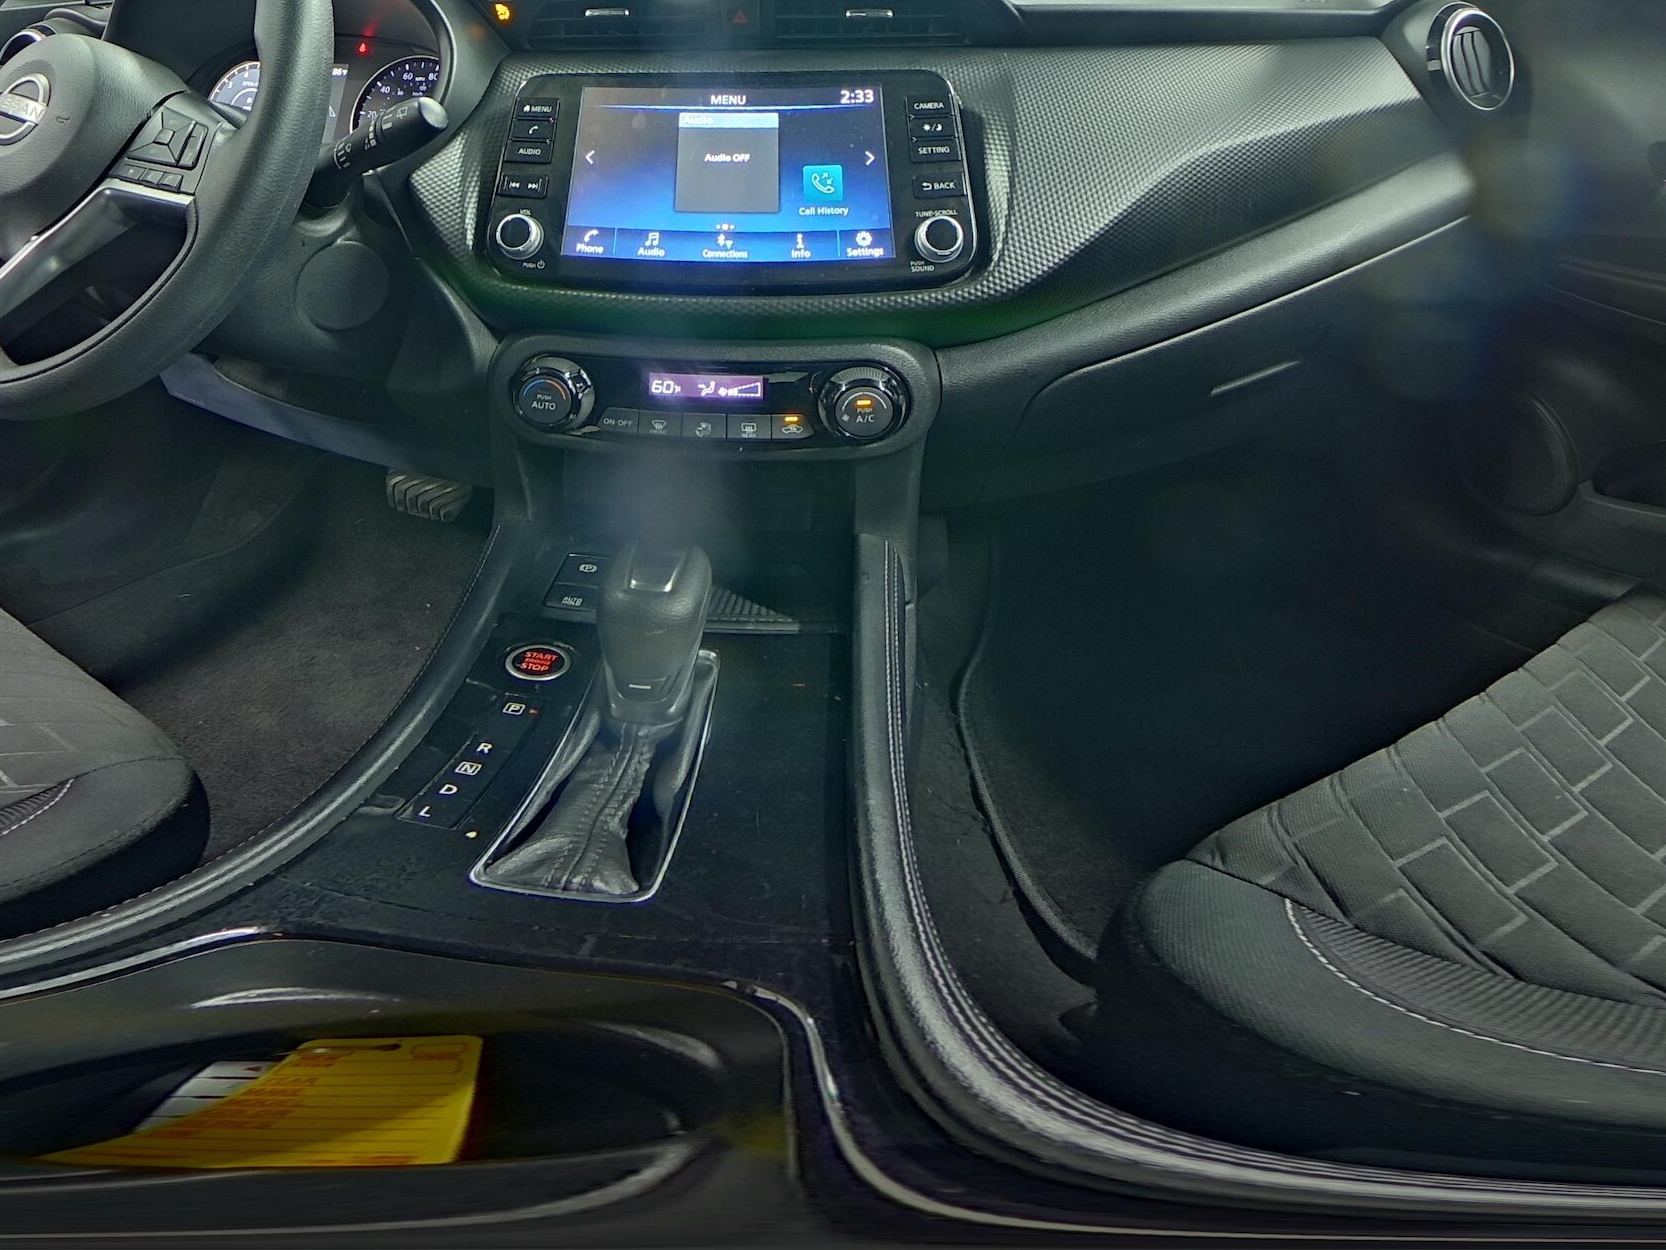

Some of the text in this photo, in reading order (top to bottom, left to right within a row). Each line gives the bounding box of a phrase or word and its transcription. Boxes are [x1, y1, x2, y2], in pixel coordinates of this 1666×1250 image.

[403, 72, 413, 80] 60
[227, 81, 234, 89] 3
[380, 86, 391, 94] 40
[711, 90, 874, 105] MENU 2:33
[531, 105, 552, 113] MENU
[914, 102, 945, 110] CAMERA
[683, 115, 714, 125] Audio
[918, 146, 950, 155] SETTING
[704, 153, 750, 162] Audio OFF
[934, 181, 956, 190] BACK
[799, 207, 849, 217] Call History
[576, 243, 604, 254] Phone
[637, 247, 665, 258] Audio
[847, 247, 884, 258] Settings
[702, 249, 749, 260] Connections
[791, 249, 811, 259] Info
[522, 261, 536, 269] PUSH
[911, 265, 935, 273] SOUND
[531, 401, 556, 411] AUTO
[856, 414, 875, 424] A/C
[524, 651, 558, 661] START
[520, 663, 549, 671] STOP
[476, 742, 493, 754] R
[438, 783, 458, 795] D
[418, 805, 431, 818] L
